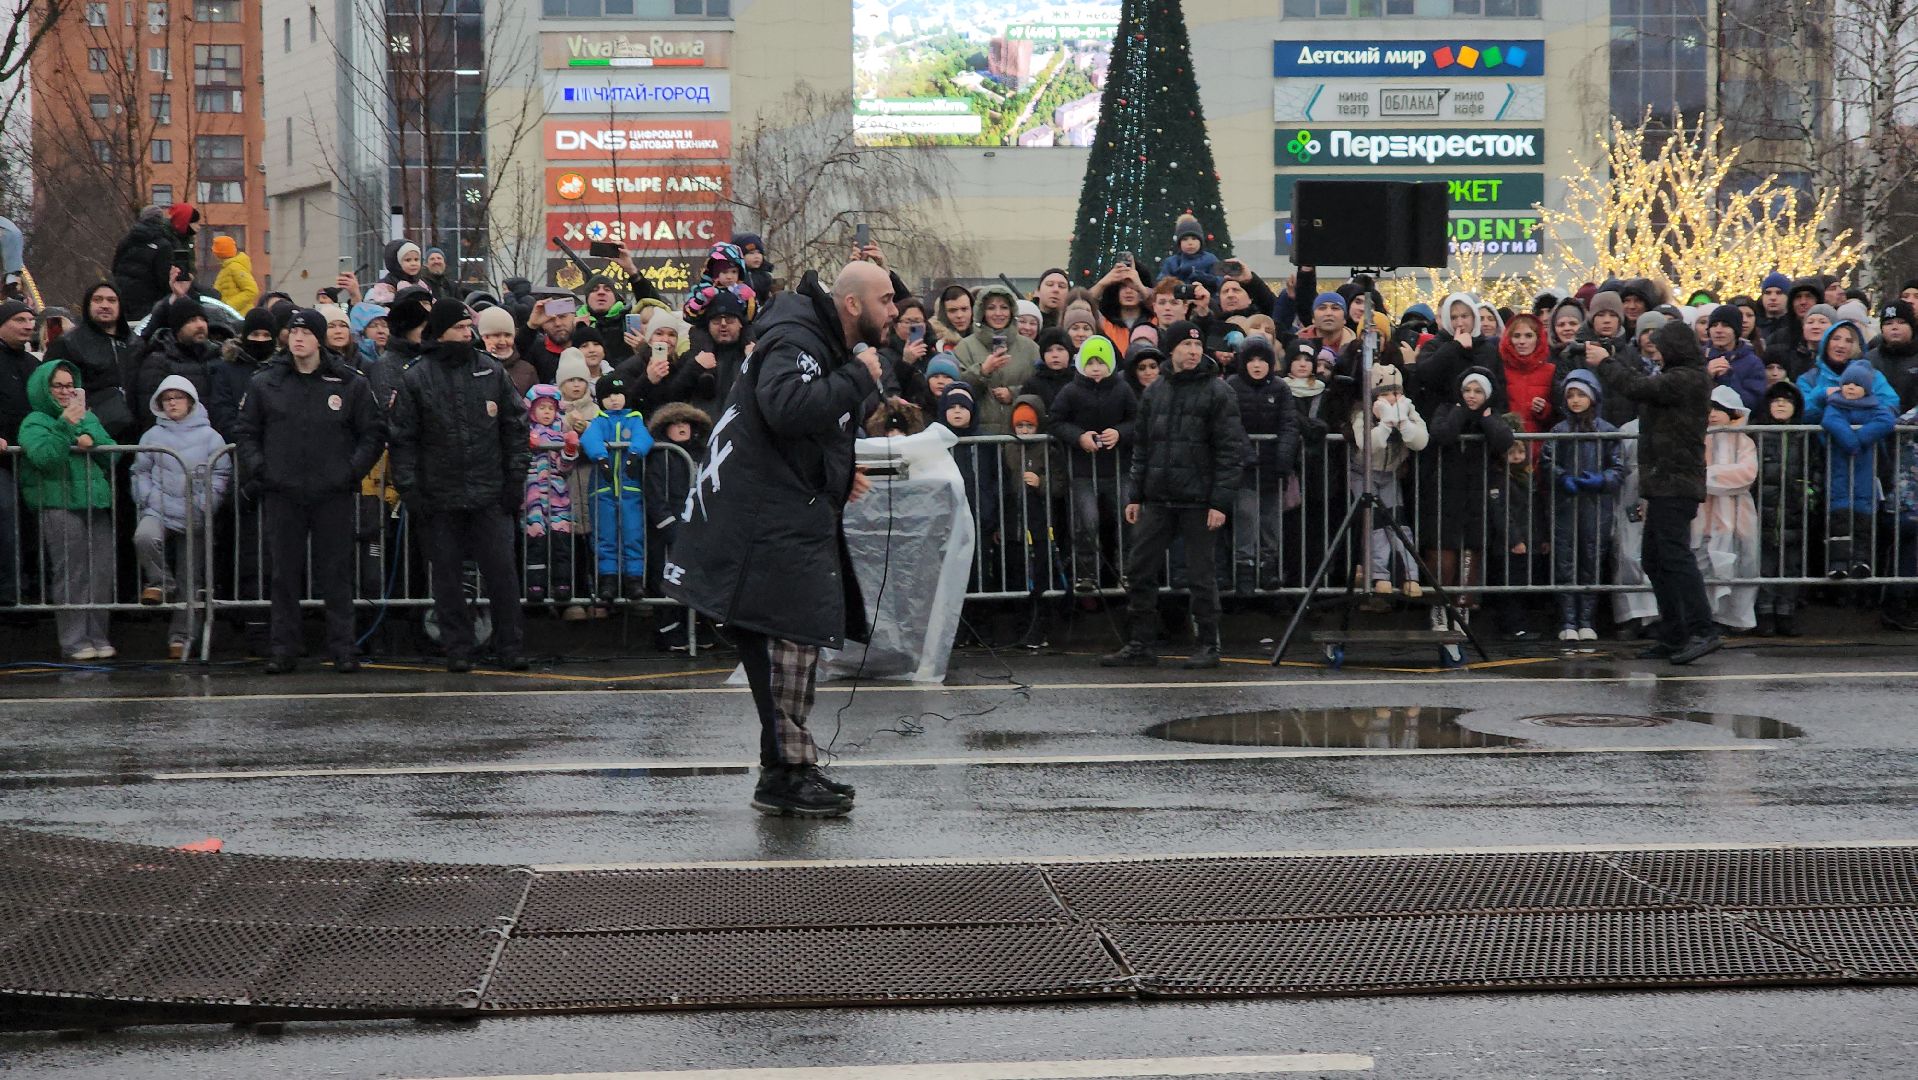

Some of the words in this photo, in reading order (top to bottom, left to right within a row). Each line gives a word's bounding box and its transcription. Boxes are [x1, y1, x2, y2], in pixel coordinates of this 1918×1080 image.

[567, 34, 613, 57] Viva
[649, 35, 705, 57] Roma
[1297, 45, 1381, 65] Детский
[1384, 48, 1426, 70] мир
[594, 83, 711, 104] ЧИТАЙ-ГОРОД
[1384, 95, 1435, 111] ОБЛАКА
[1337, 104, 1370, 117] театр
[1454, 103, 1485, 117] кафе
[555, 129, 627, 151] DNS
[629, 129, 684, 141] ЦИФРОВАЯ
[684, 130, 693, 139] И
[629, 139, 675, 150] БЫТОВАЯ
[675, 140, 719, 150] ТЕХНИКА
[1330, 130, 1536, 164] Перекресток
[591, 176, 662, 193] ЧЕТЫРЕ
[665, 176, 723, 192] ЛАПЫ
[1448, 179, 1503, 202] РКЕТ
[563, 220, 716, 242] ХОЗМАКС
[1448, 218, 1537, 240] DENT
